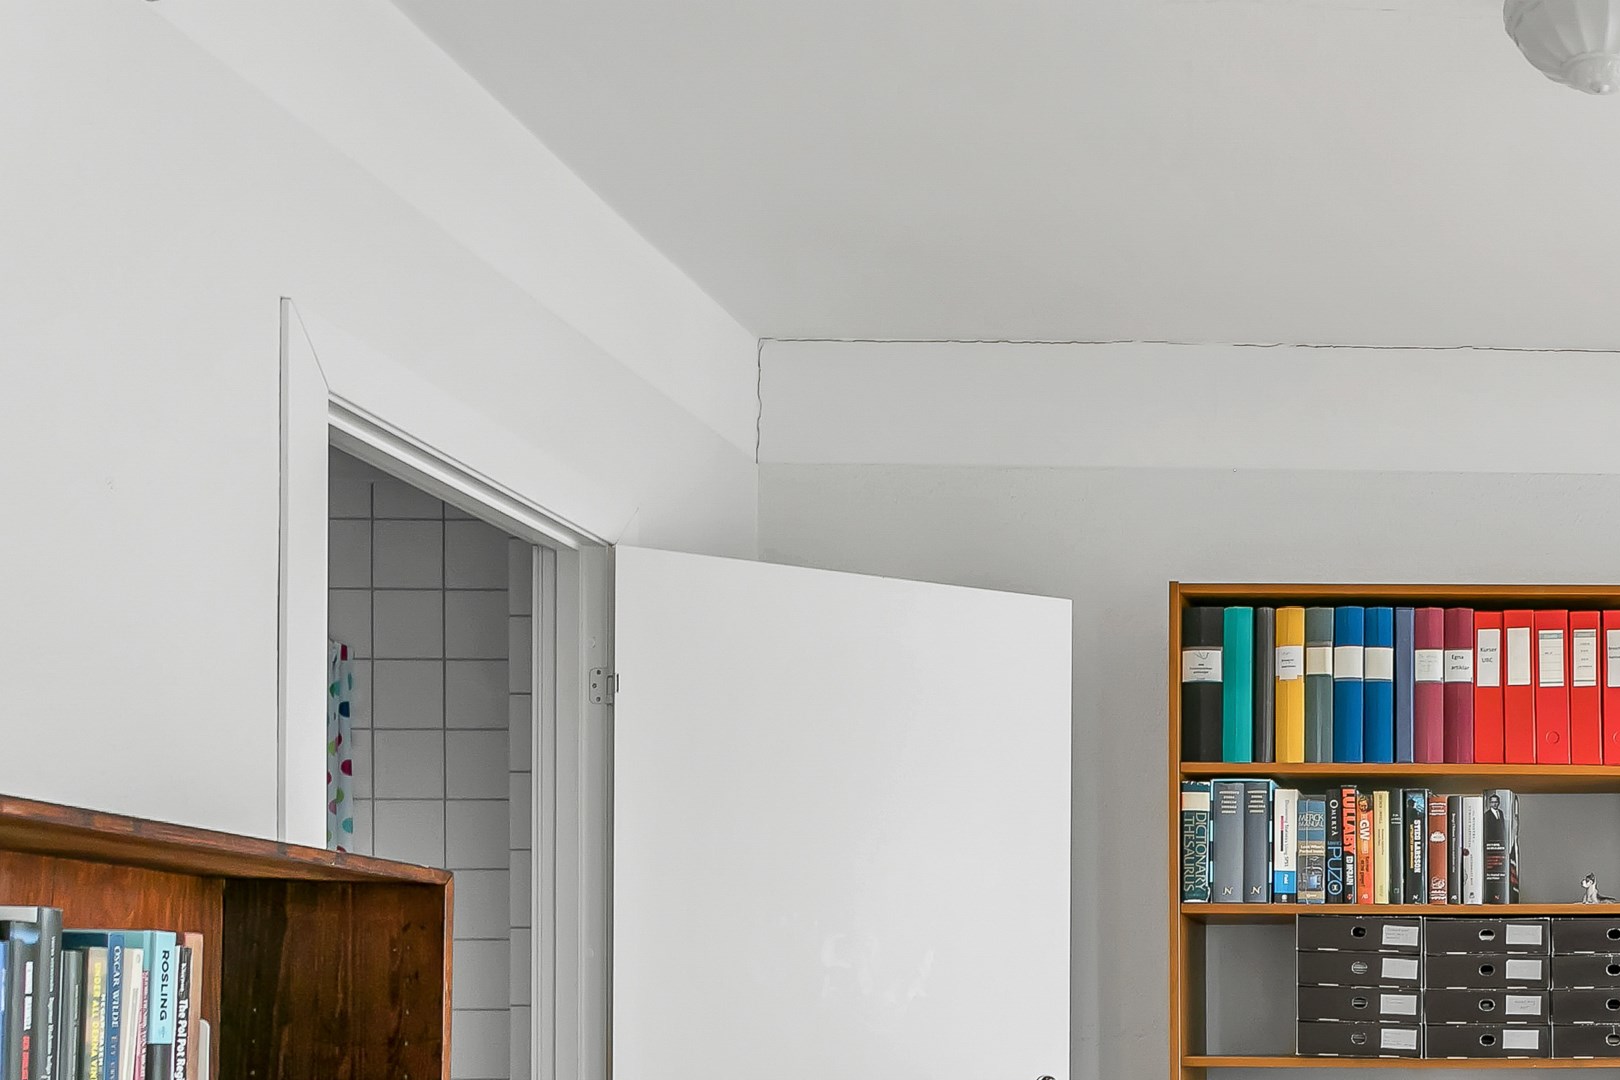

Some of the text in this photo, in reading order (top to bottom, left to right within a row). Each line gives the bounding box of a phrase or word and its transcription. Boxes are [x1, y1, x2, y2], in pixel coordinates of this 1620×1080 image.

[1184, 816, 1195, 892] THESAURUS
[1195, 812, 1206, 891] DICTIONARY
[1342, 789, 1355, 855] LULLABY
[1327, 847, 1342, 895] PUZO
[91, 1001, 100, 1018] ALL
[92, 962, 101, 998] UNDER
[111, 946, 121, 1028] OSCAR WILDE
[160, 950, 170, 1021] ROSLING
[179, 999, 188, 1018] The
